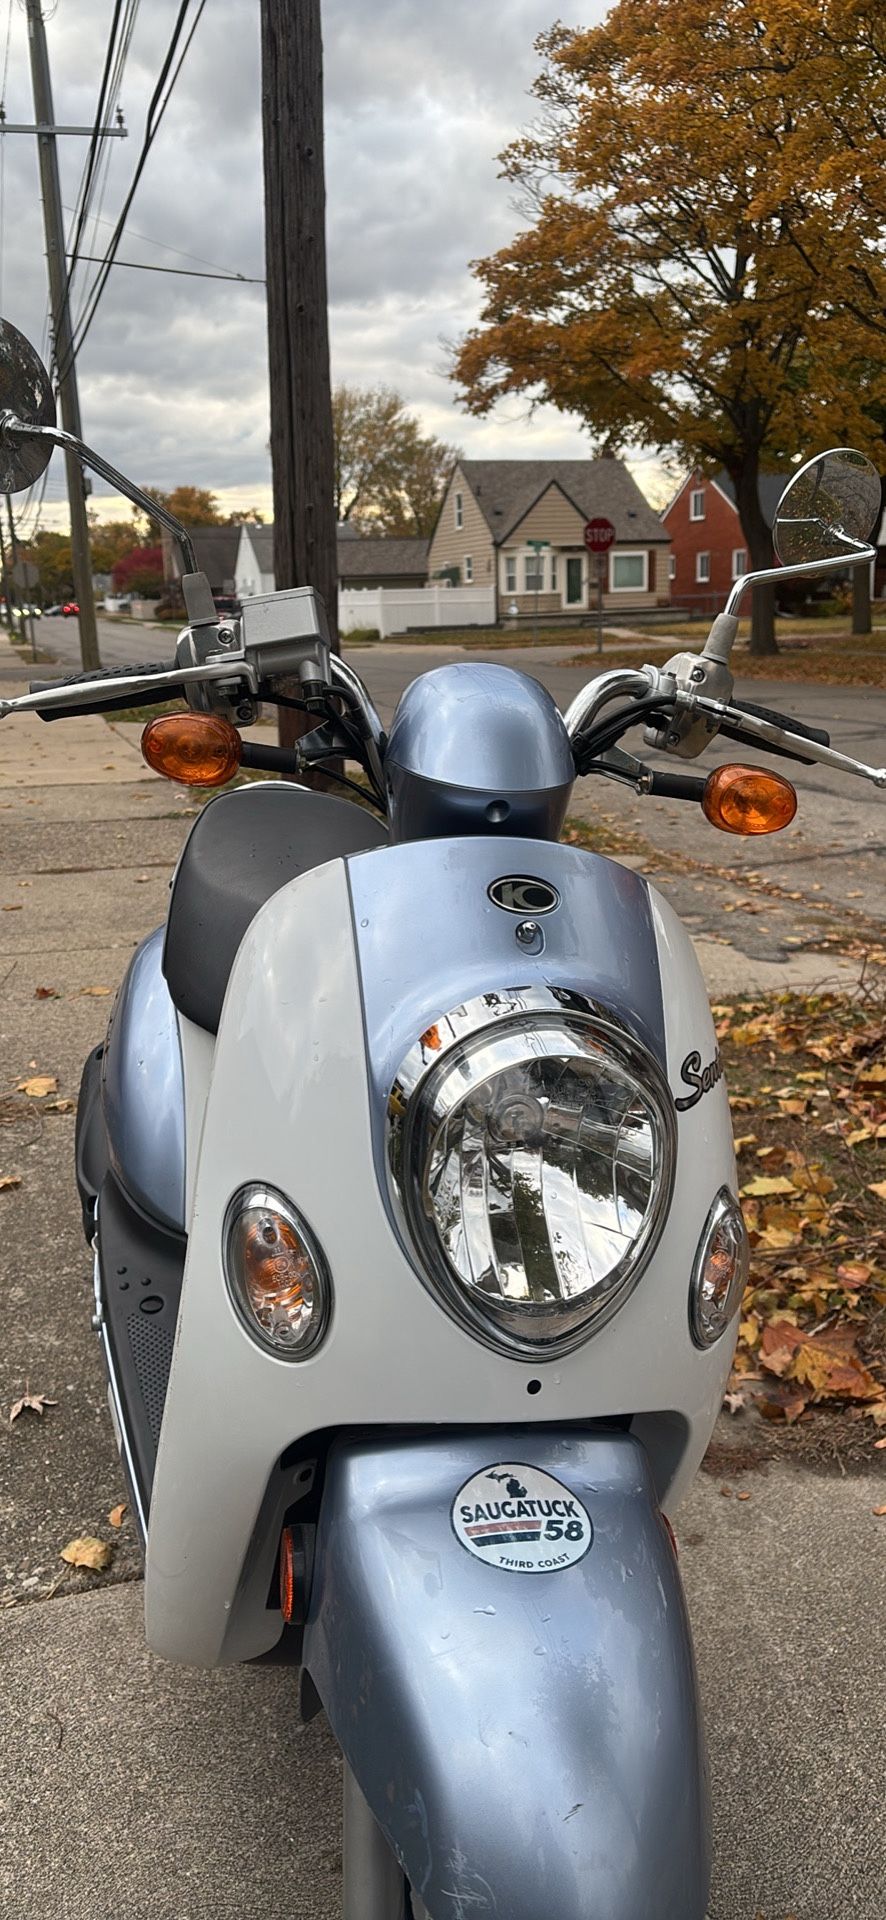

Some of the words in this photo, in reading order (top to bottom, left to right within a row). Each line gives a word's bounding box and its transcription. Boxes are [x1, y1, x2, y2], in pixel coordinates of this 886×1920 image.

[586, 527, 613, 542] STOP
[460, 1500, 581, 1524] SAUGATUCK
[543, 1519, 584, 1542] 58
[499, 1556, 534, 1569] THIRD
[538, 1552, 571, 1568] COAST
